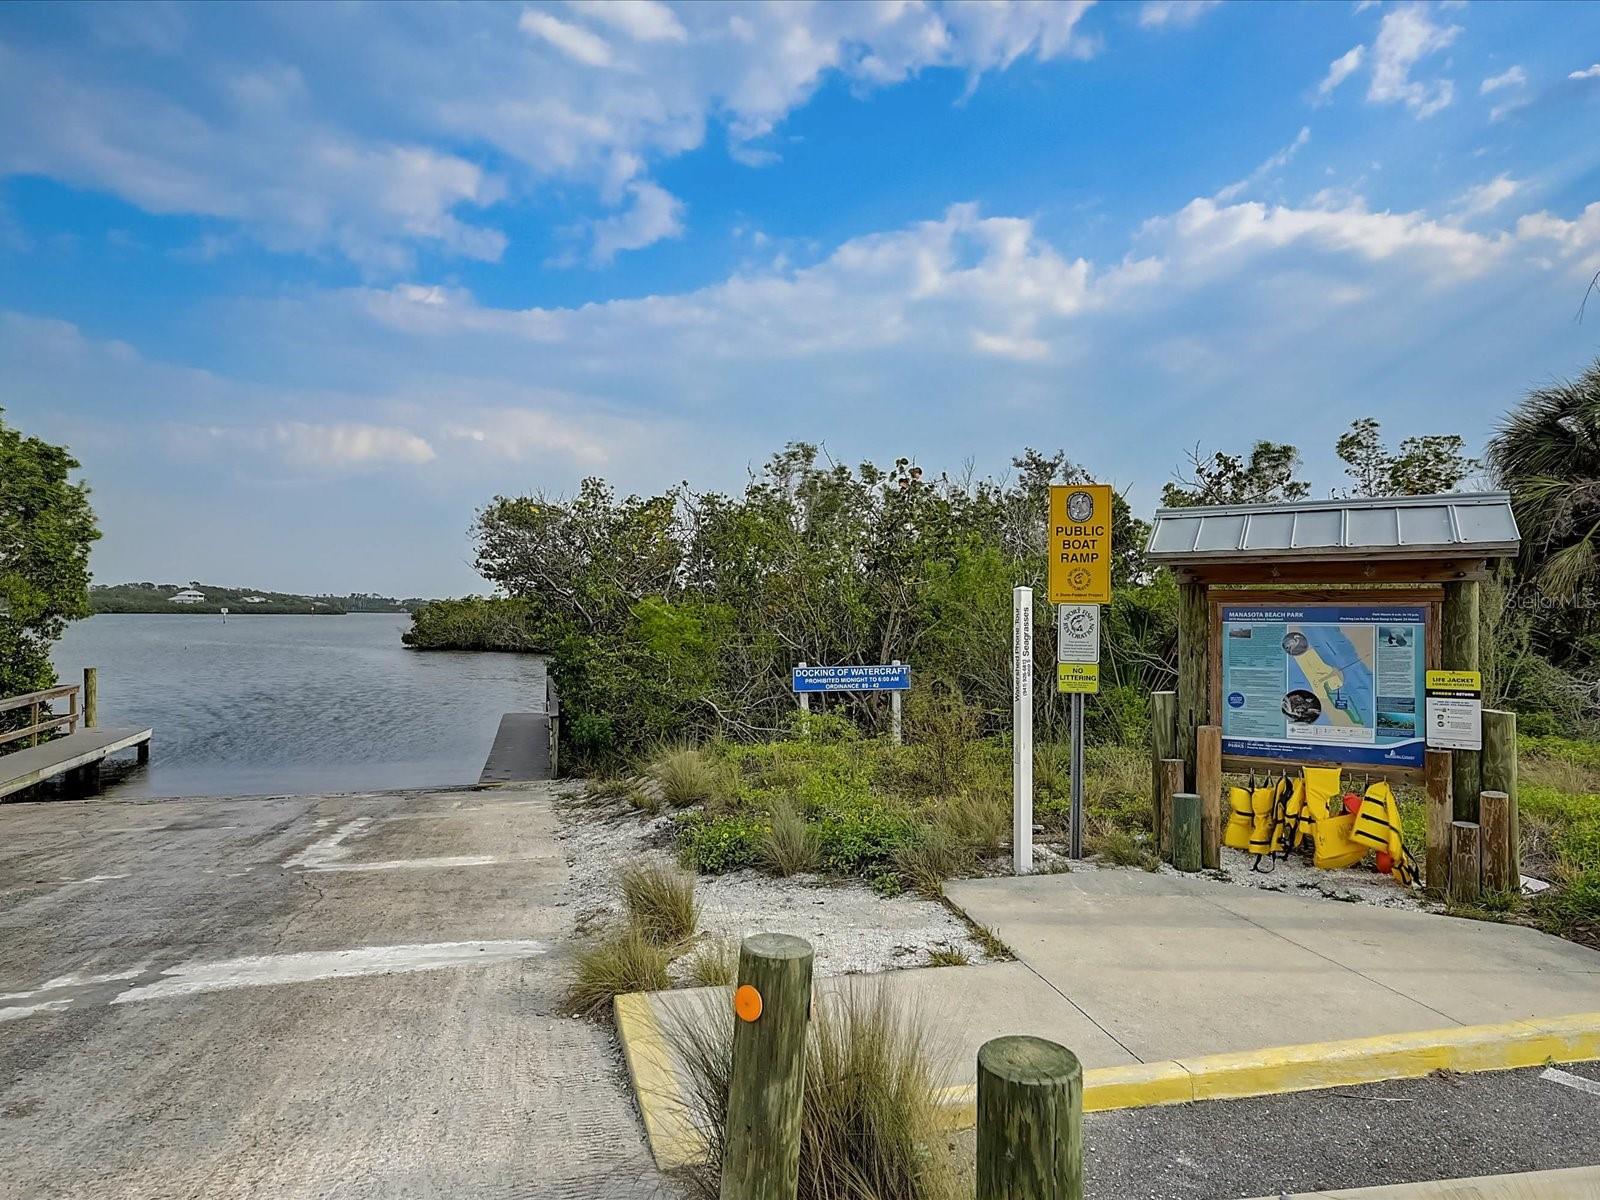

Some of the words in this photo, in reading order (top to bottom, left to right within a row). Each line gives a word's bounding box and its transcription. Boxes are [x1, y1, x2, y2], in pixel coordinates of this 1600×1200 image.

[1056, 526, 1104, 536] PUBLIC
[1062, 539, 1098, 550] BOAT
[1060, 553, 1099, 563] RAMP
[1064, 608, 1081, 621] SPORT
[1082, 609, 1095, 621] FISH
[1022, 607, 1031, 657] Seagrasses
[1063, 622, 1095, 640] RESTORATION
[795, 669, 835, 677] DOCKING
[850, 667, 908, 676] WATERCRAFT
